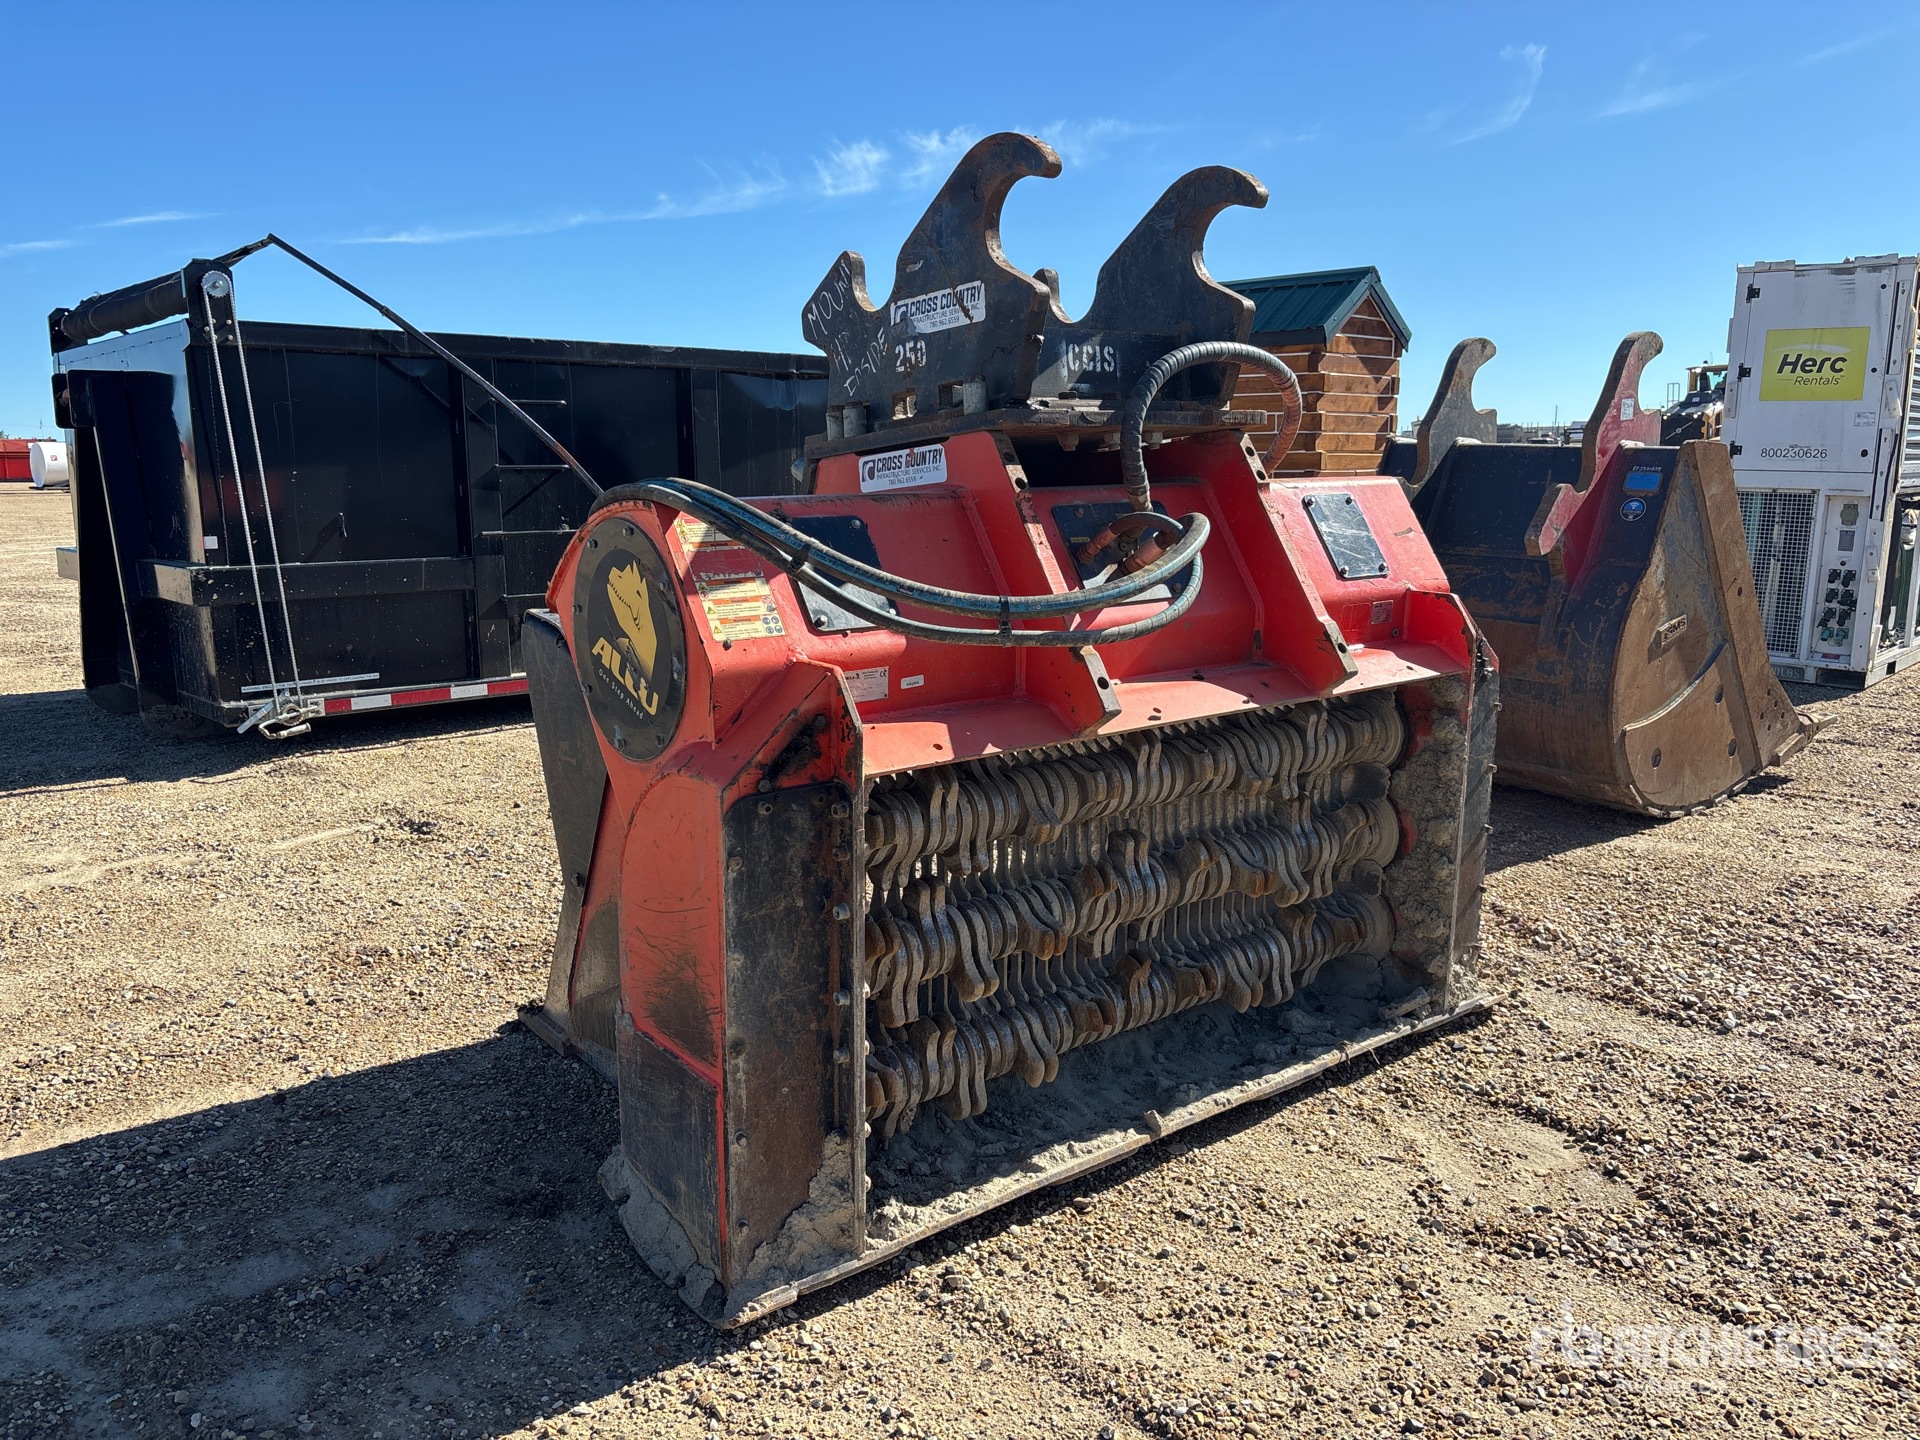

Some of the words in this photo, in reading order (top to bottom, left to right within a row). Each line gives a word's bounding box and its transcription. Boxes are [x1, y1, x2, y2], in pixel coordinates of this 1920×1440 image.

[910, 296, 938, 318] CROSS
[940, 285, 982, 310] COUNTRY
[929, 316, 960, 328] 780.962.6559
[895, 339, 927, 373] 250
[1068, 343, 1115, 373] CCIS
[1776, 353, 1848, 374] Herc
[1793, 375, 1841, 386] Rentals
[876, 454, 903, 473] CROSS
[905, 447, 943, 469] COUNTRY
[1760, 448, 1828, 459] 800230626
[877, 468, 911, 481] INFRASTRUCTURE
[912, 467, 932, 475] SERVICES
[888, 476, 917, 486] 780.962.6559
[591, 636, 659, 716] ALLU
[598, 668, 610, 684] One
[611, 681, 625, 700] Step
[625, 697, 644, 720] Ahead
